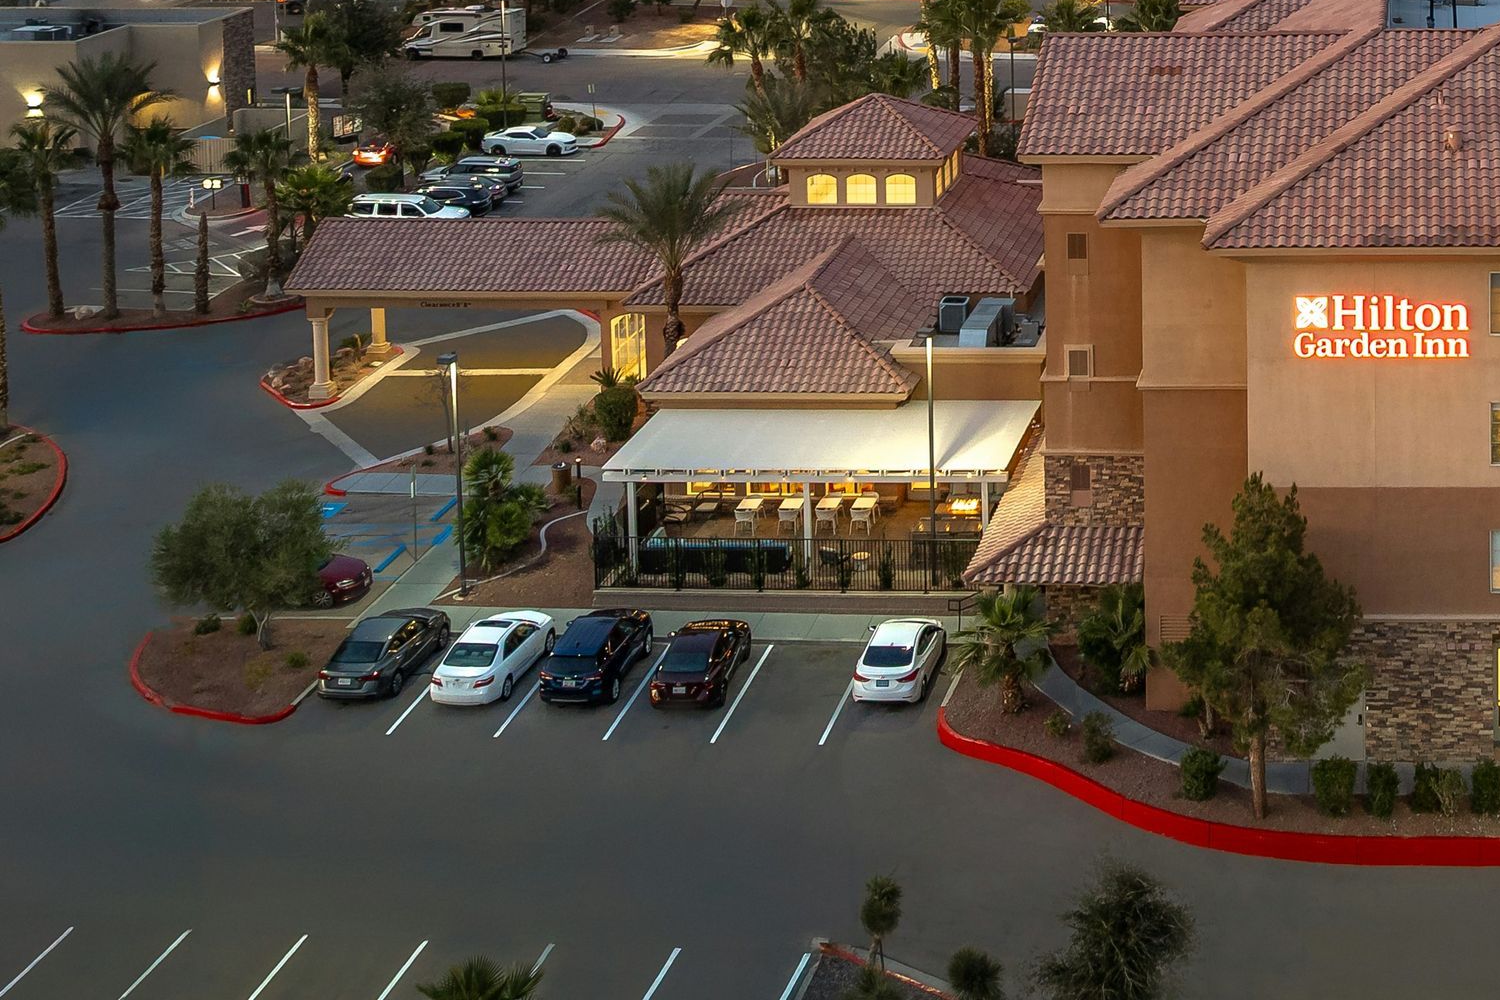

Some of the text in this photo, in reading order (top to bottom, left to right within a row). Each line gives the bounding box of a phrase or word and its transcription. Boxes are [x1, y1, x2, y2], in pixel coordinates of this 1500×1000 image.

[1332, 295, 1470, 331] Hilton
[1294, 332, 1470, 358] Garden Inn
